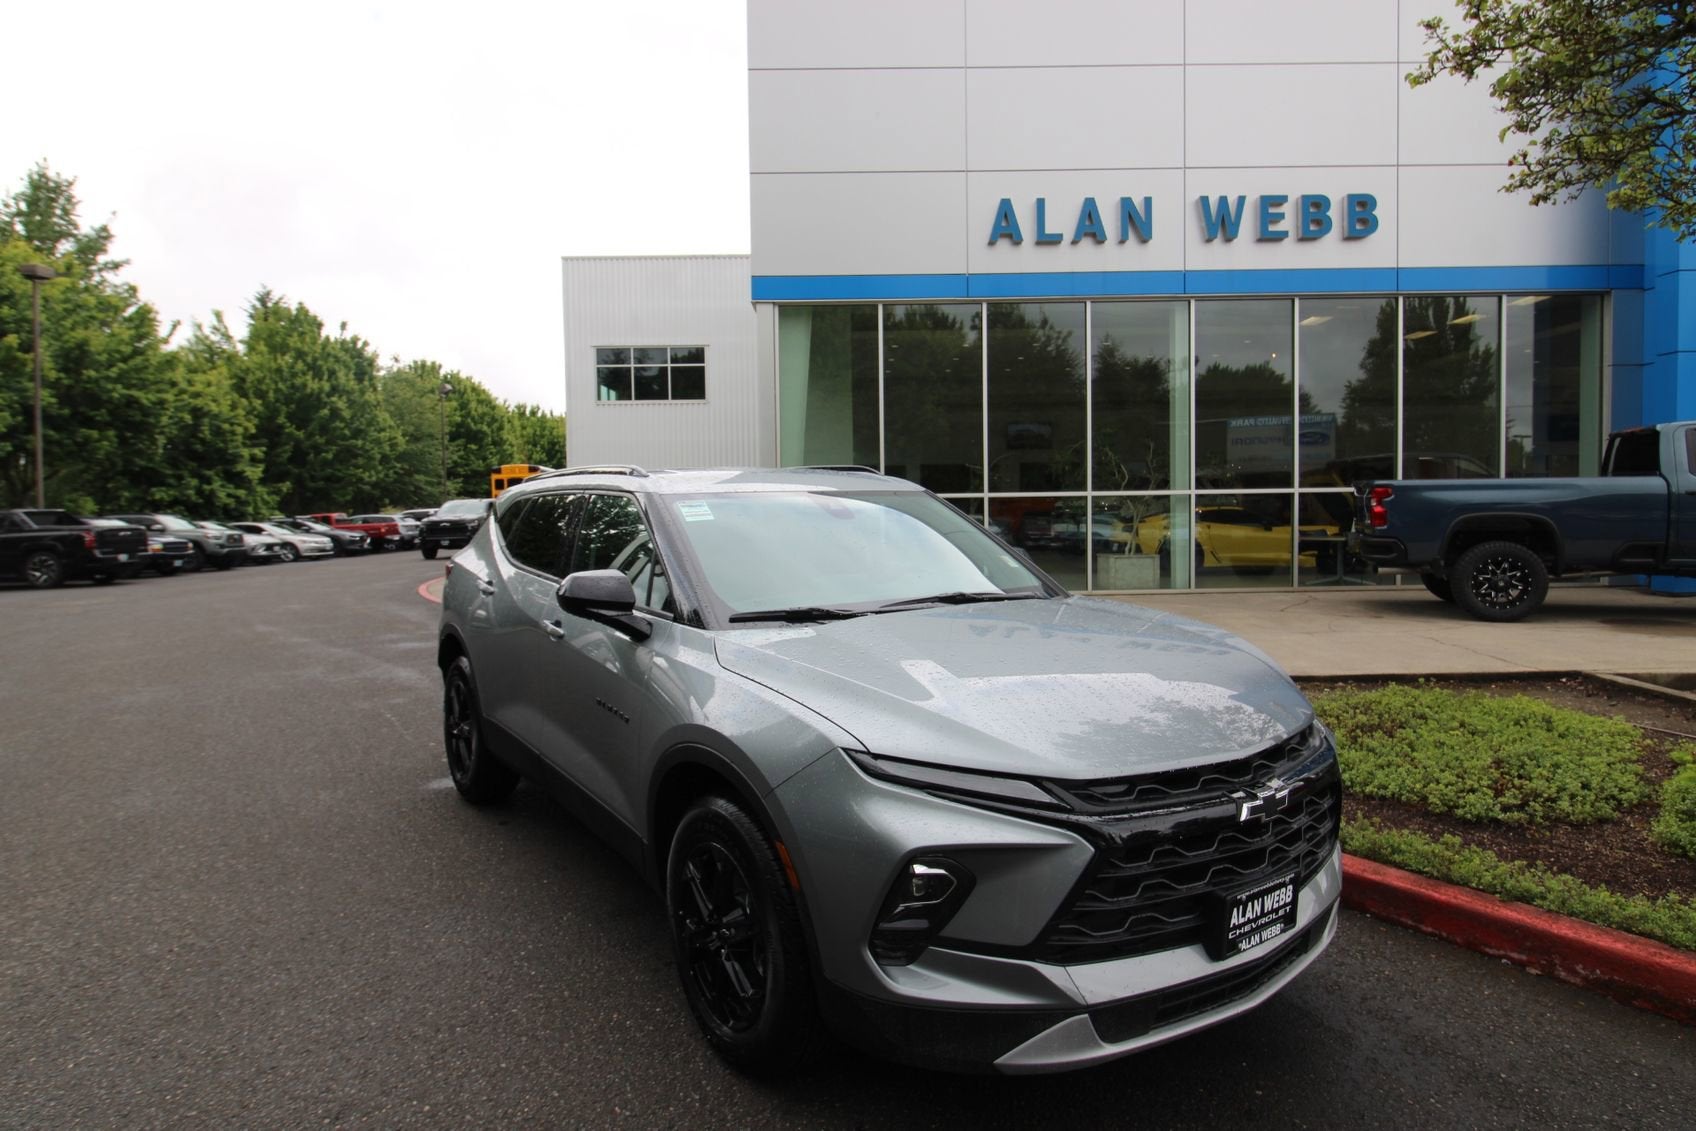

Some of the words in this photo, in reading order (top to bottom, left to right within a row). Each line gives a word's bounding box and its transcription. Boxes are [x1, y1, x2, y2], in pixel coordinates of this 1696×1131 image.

[988, 196, 1154, 245] ALAN
[1195, 193, 1379, 242] WEBB
[1228, 905, 1292, 939] CHEVROLET
[1230, 897, 1262, 928] ALAN
[1264, 885, 1293, 913] WEBB
[1241, 932, 1260, 950] ALAN
[1261, 923, 1281, 942] WEBB
